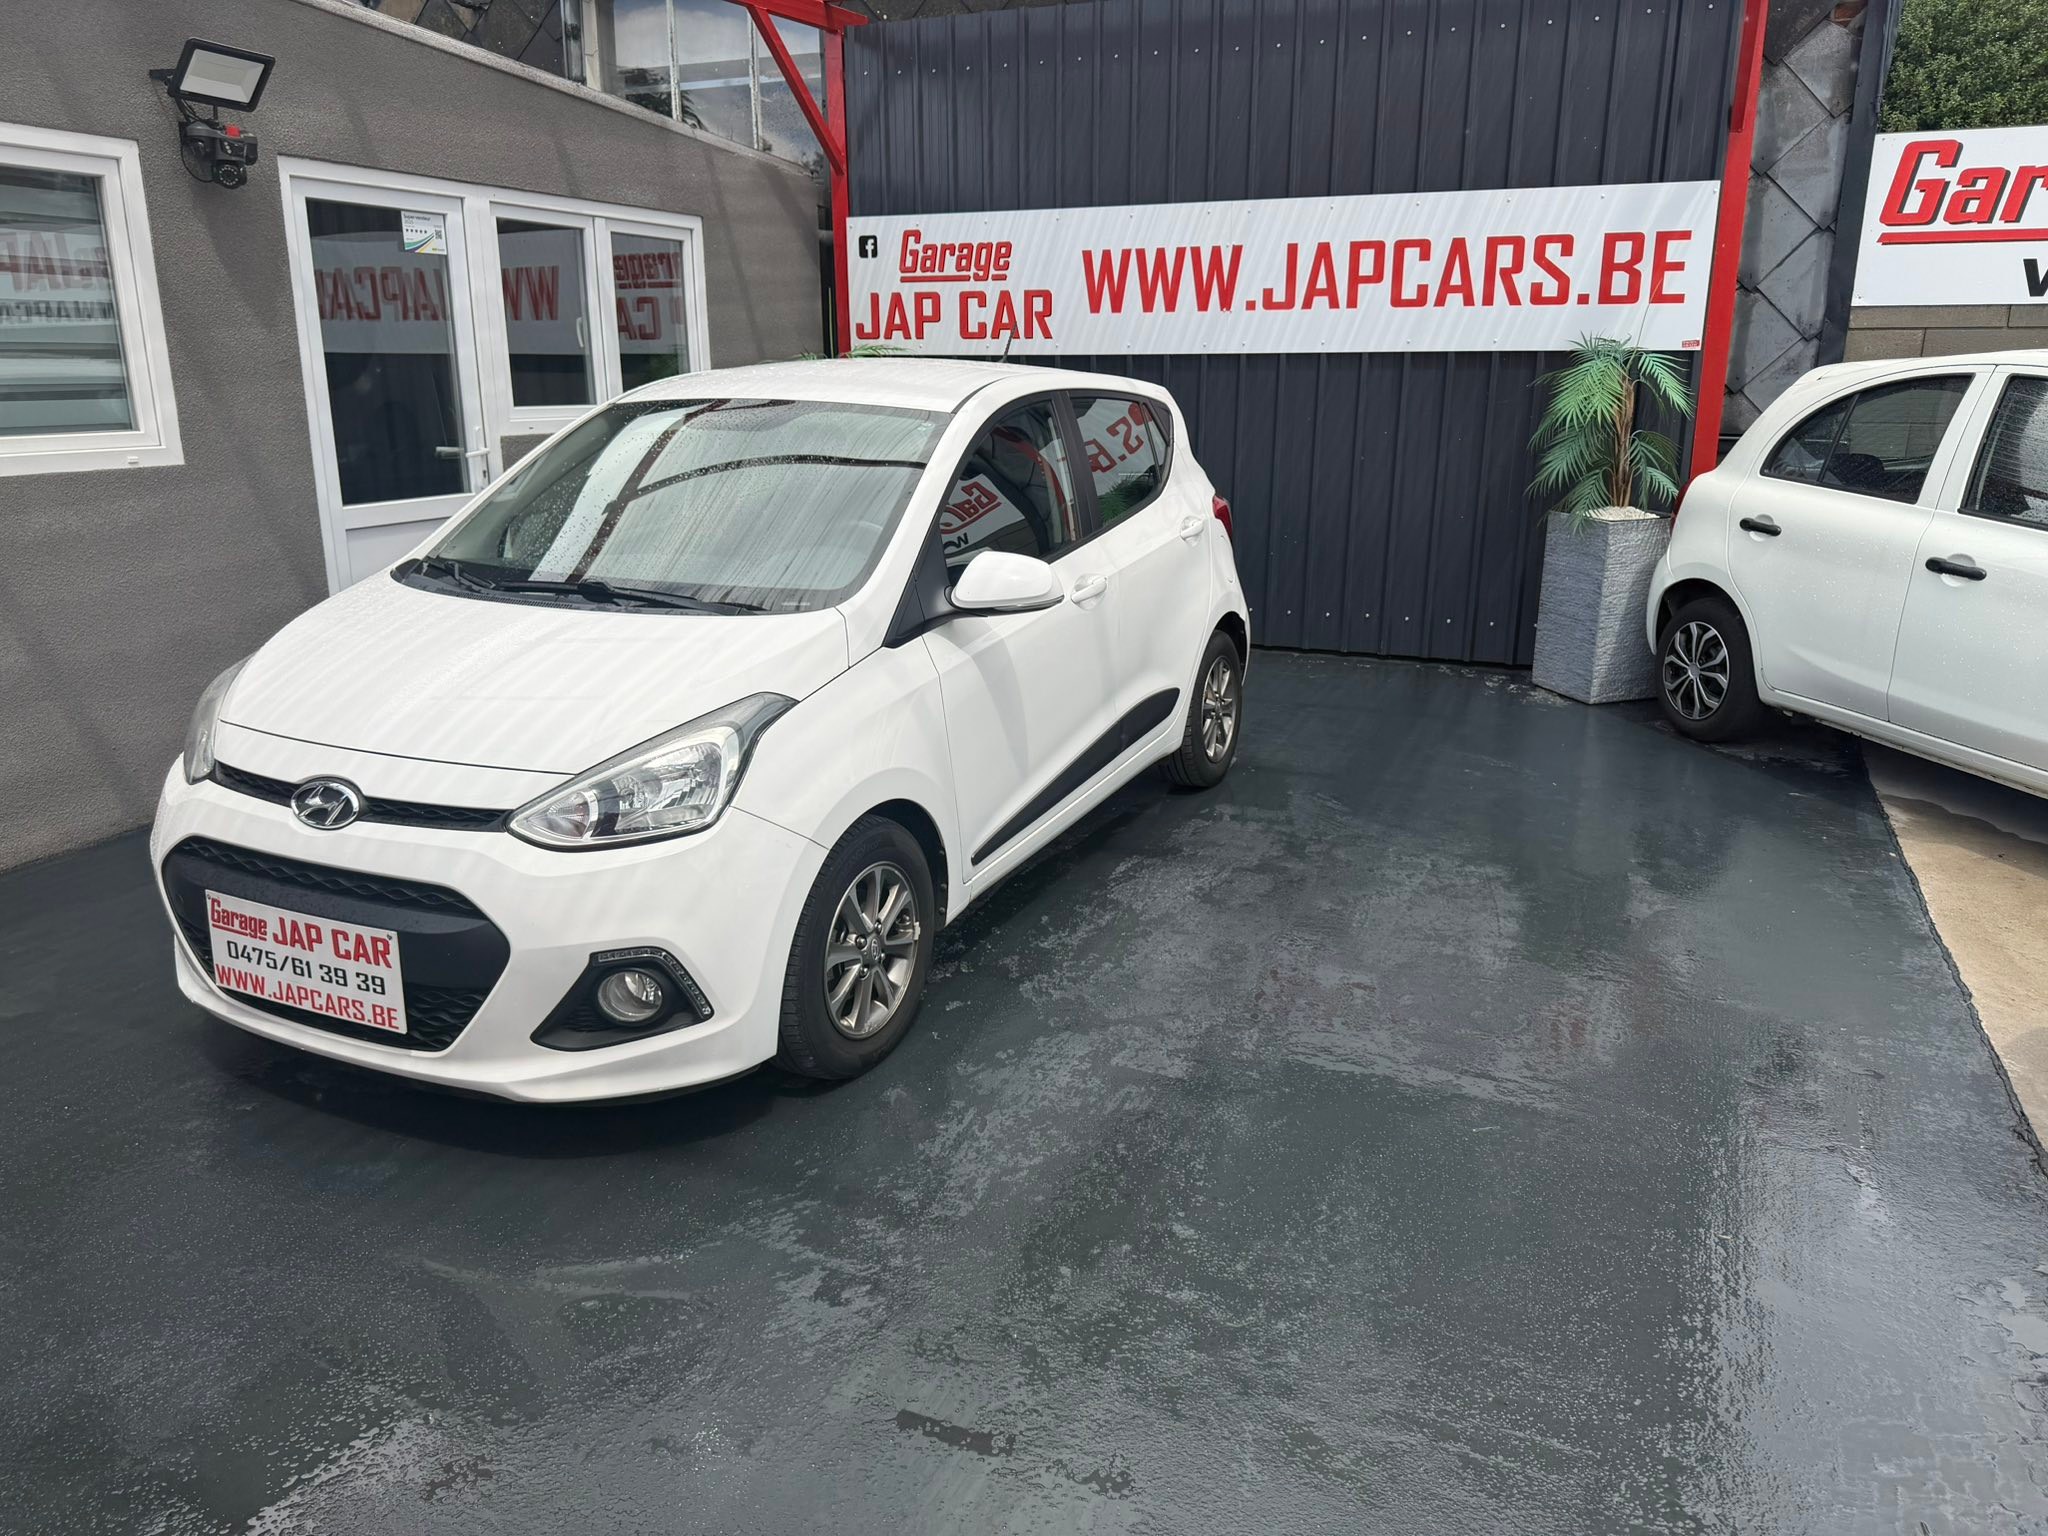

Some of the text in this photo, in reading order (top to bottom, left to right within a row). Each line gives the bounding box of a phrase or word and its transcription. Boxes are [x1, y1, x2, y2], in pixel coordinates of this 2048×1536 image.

[900, 229, 1012, 281] Garage
[1081, 229, 1693, 313] WWW.JAPCARS.BE
[855, 289, 1053, 340] JAP CAR
[210, 897, 392, 969] Garage JAP CAR
[216, 963, 400, 1030] WWW.JAPCARS.BE
[226, 940, 386, 995] 0475/61 39 39
